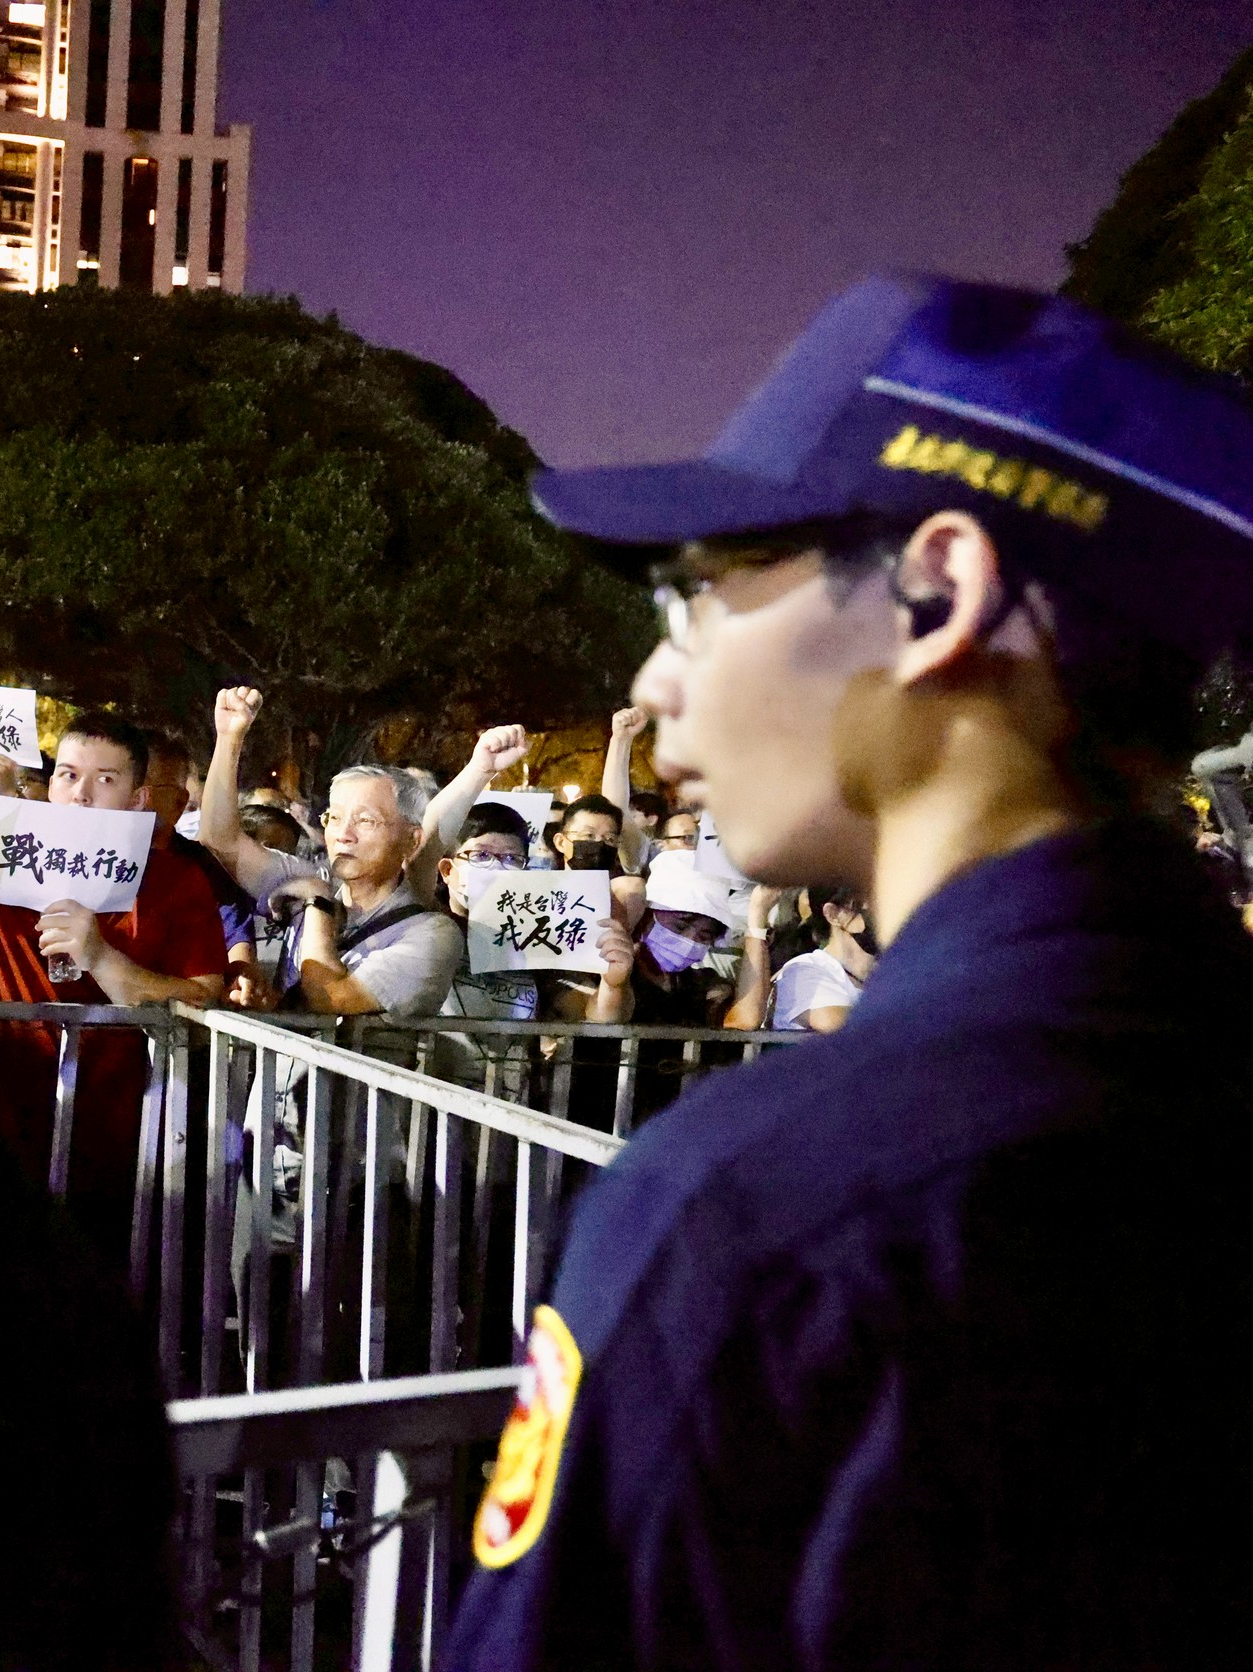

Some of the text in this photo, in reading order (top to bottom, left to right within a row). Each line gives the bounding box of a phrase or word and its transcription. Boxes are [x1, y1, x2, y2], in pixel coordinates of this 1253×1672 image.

[497, 889, 596, 915] 我是台灣人
[492, 915, 588, 956] 我反綠
